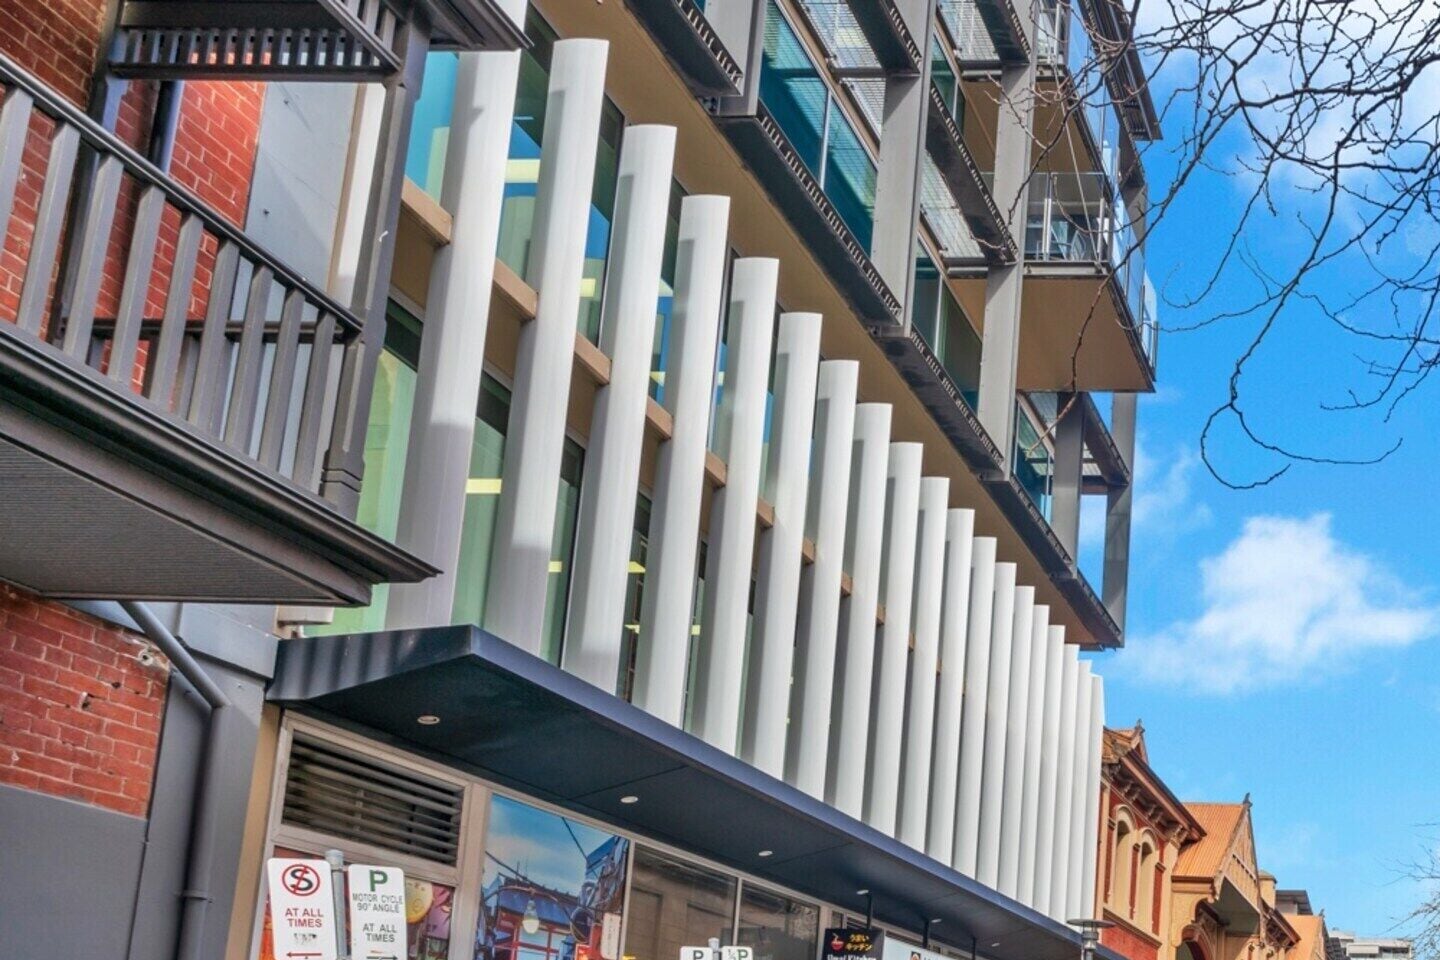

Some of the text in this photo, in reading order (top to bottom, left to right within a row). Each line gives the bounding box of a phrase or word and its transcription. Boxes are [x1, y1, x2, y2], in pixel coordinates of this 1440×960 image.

[369, 869, 389, 892] P
[352, 893, 403, 905] MOTOR CYCLE
[285, 908, 324, 918] AT ALL
[372, 904, 400, 913] ANGLE
[287, 918, 322, 928] TIMES
[362, 923, 397, 933] AT ALL
[366, 933, 395, 943] TIMES
